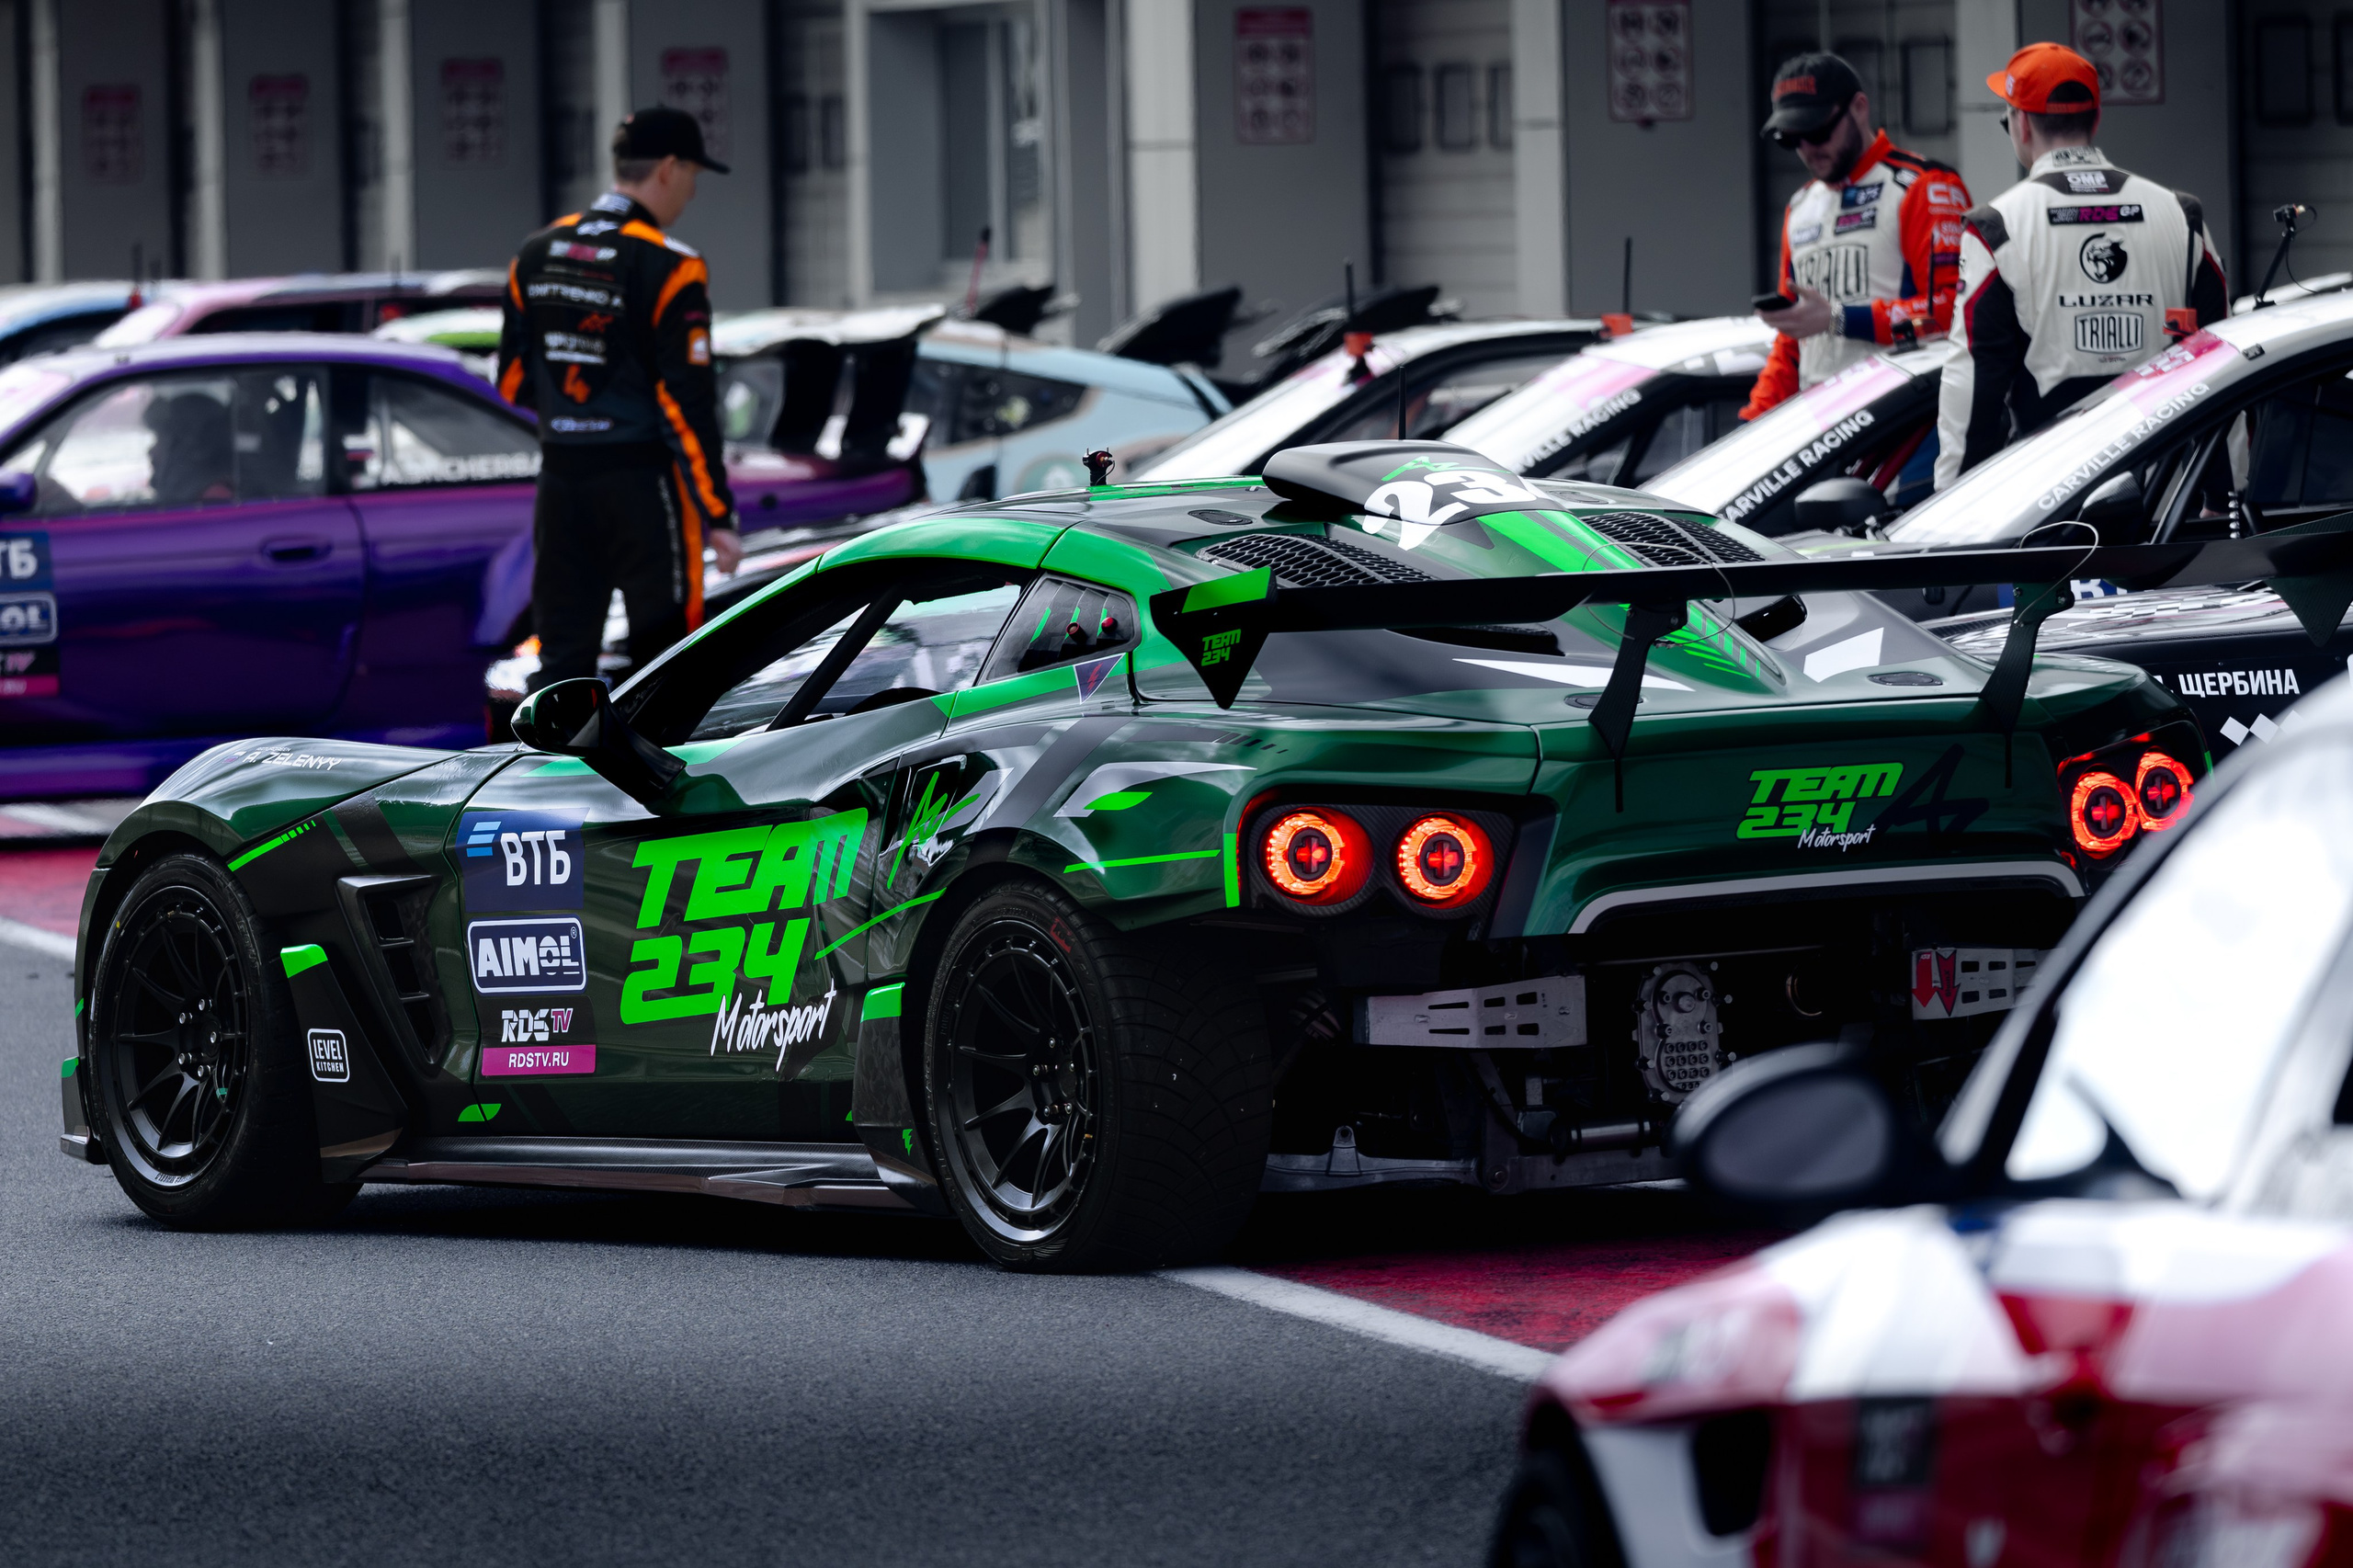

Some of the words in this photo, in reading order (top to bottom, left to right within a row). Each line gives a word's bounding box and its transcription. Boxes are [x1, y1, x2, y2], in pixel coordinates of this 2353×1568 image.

[2067, 173, 2107, 186] OMP
[2059, 293, 2154, 308] LUZAR
[2078, 315, 2139, 350] TRIALLI
[2037, 437, 2132, 511] CARVILLE
[2132, 381, 2211, 441] RACING
[1720, 460, 1803, 523] ARVILLE
[1798, 410, 1875, 468] RACING
[1200, 646, 1231, 667] 234
[1201, 629, 1241, 652] TEAM
[2178, 668, 2300, 699] ЩЕРБИНА
[261, 752, 342, 771] ZELENYY
[1749, 762, 1904, 804] TEAM
[1736, 801, 1857, 839] 234
[1797, 824, 1876, 853] Motorsport
[500, 830, 572, 887] ВТБ
[631, 807, 869, 930] TEAM
[477, 935, 580, 978] AIMOL
[620, 917, 811, 1026] 234
[710, 978, 837, 1073] Motorsport
[313, 1039, 343, 1061] LEVEL
[508, 1051, 570, 1069] RDSTV.RU
[315, 1061, 345, 1074] KITCHEN
